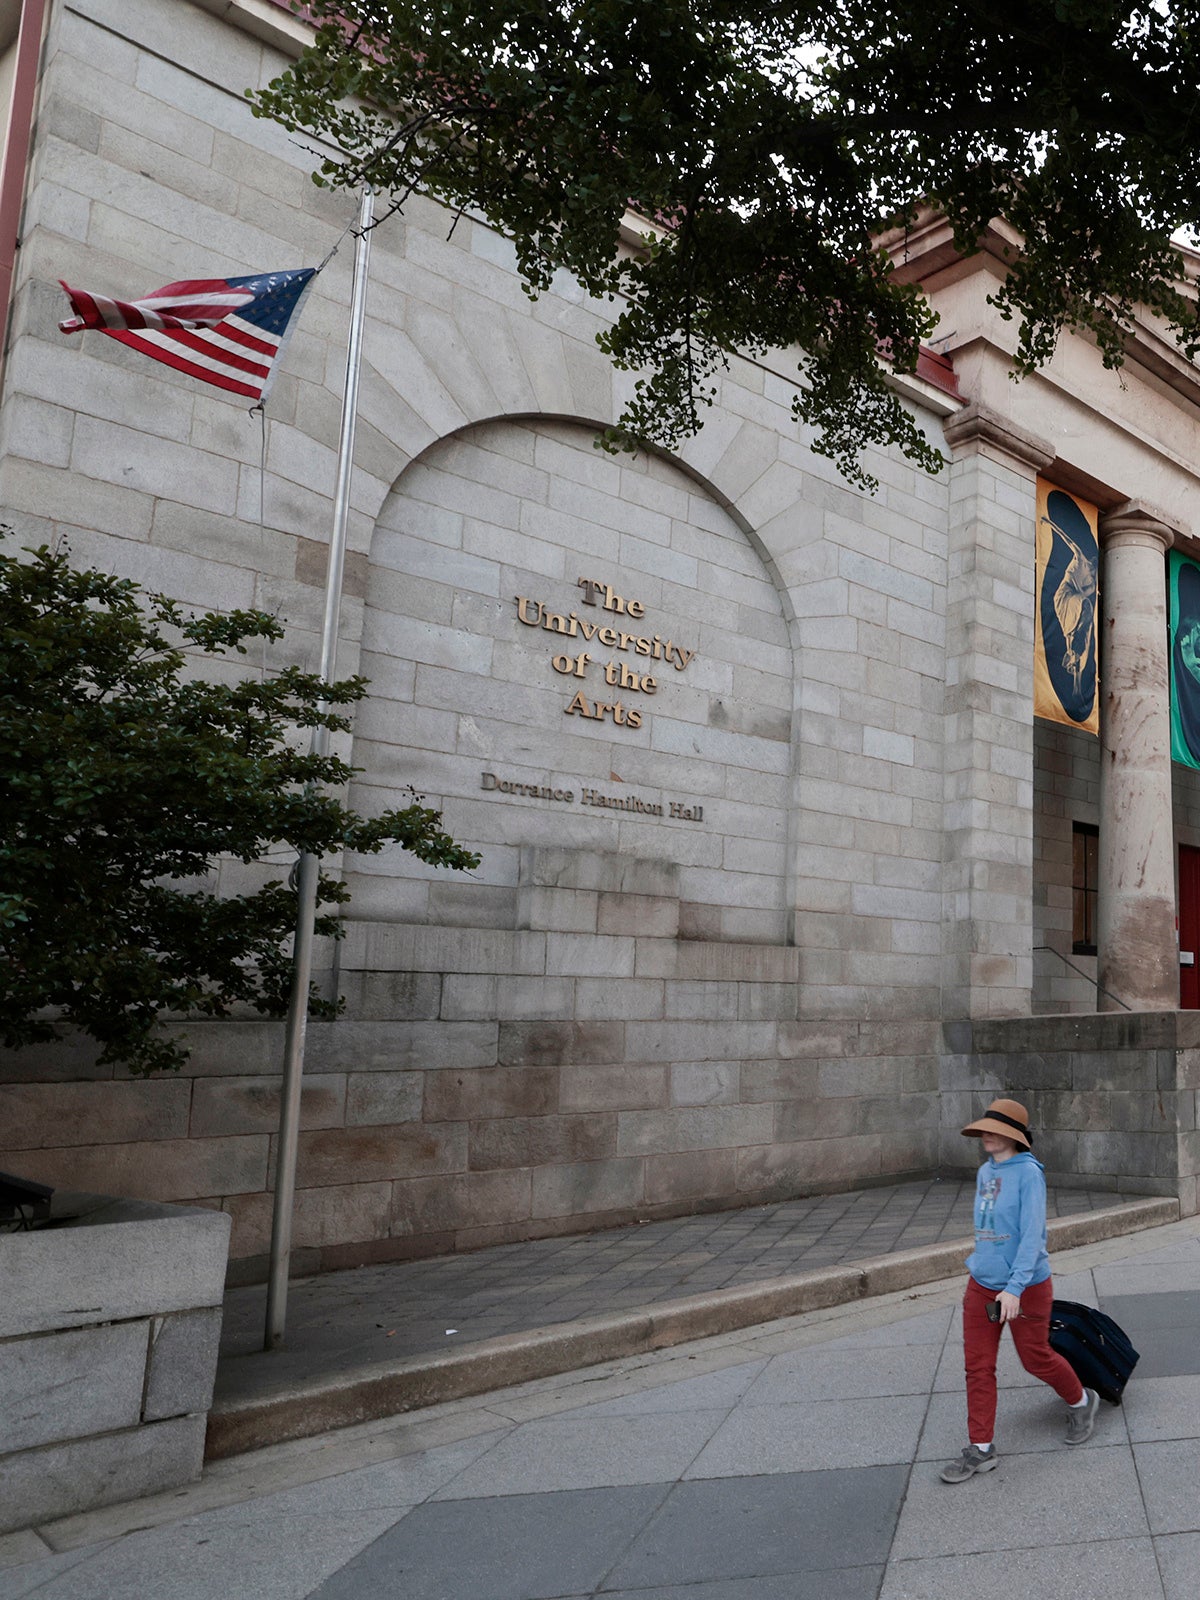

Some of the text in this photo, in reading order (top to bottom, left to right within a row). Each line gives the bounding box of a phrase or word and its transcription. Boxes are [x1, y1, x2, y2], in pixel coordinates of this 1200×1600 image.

[578, 576, 645, 618] The
[514, 596, 696, 671] University
[552, 653, 658, 694] of the
[564, 690, 643, 729] Arts
[481, 772, 704, 822] Dorrance Hamilton Hall
